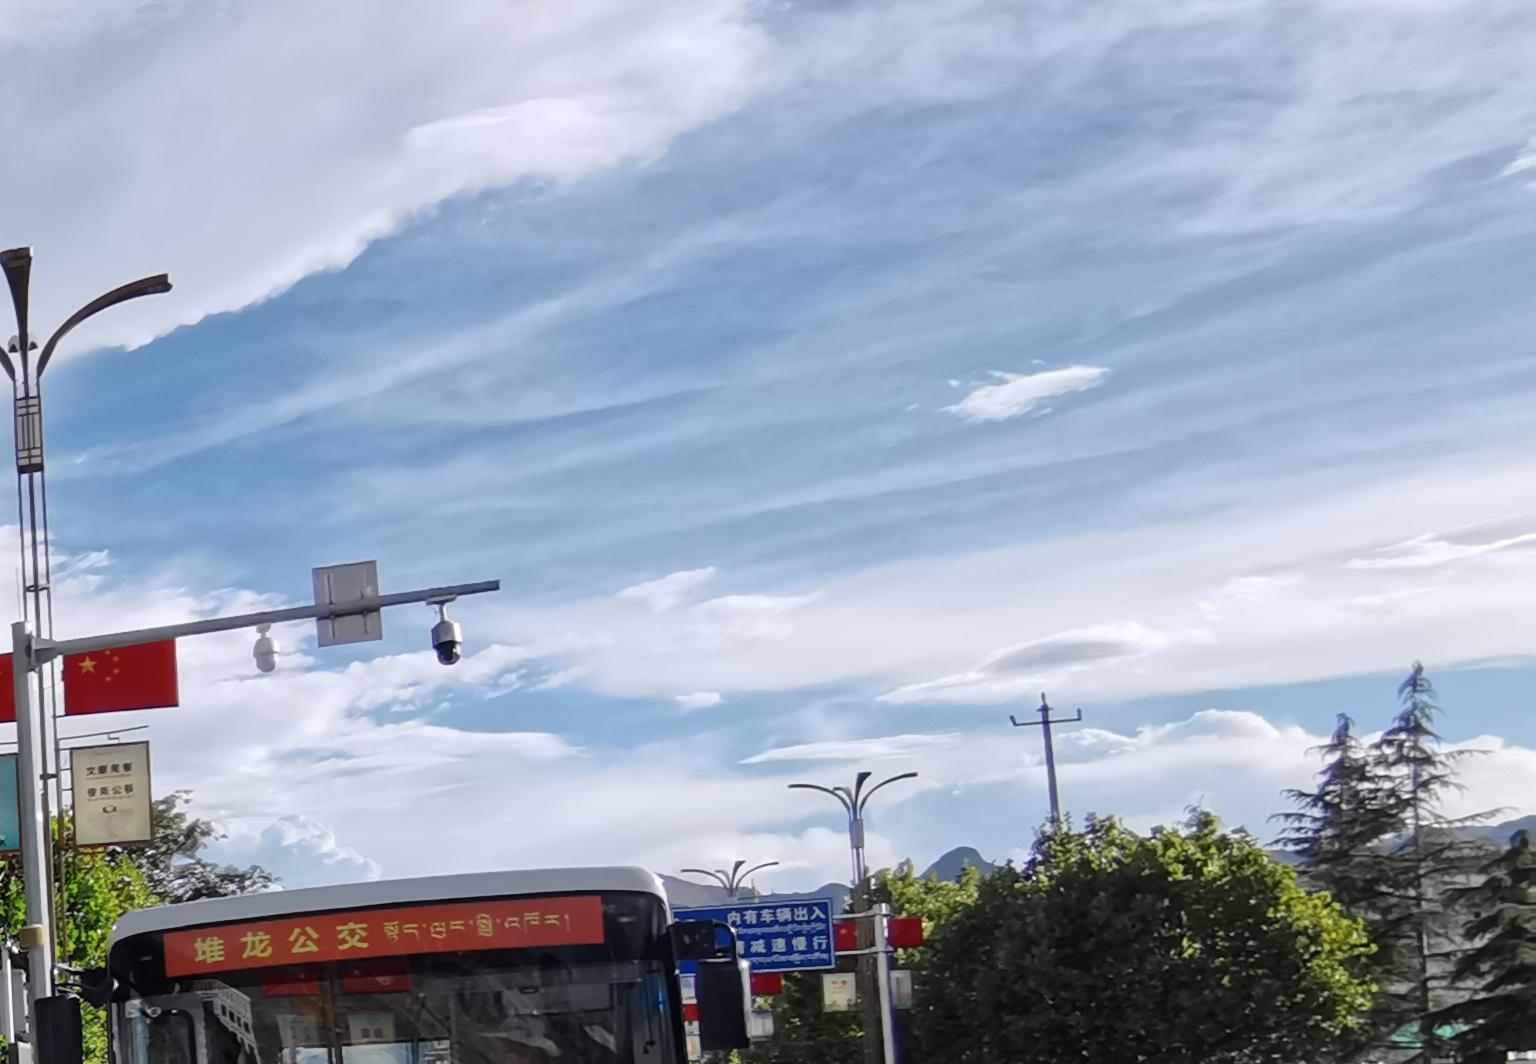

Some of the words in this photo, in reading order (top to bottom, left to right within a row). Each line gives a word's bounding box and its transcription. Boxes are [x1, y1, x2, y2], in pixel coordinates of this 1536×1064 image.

[727, 906, 826, 925] 内有车辆出入
[193, 921, 370, 964] 堆龙公交
